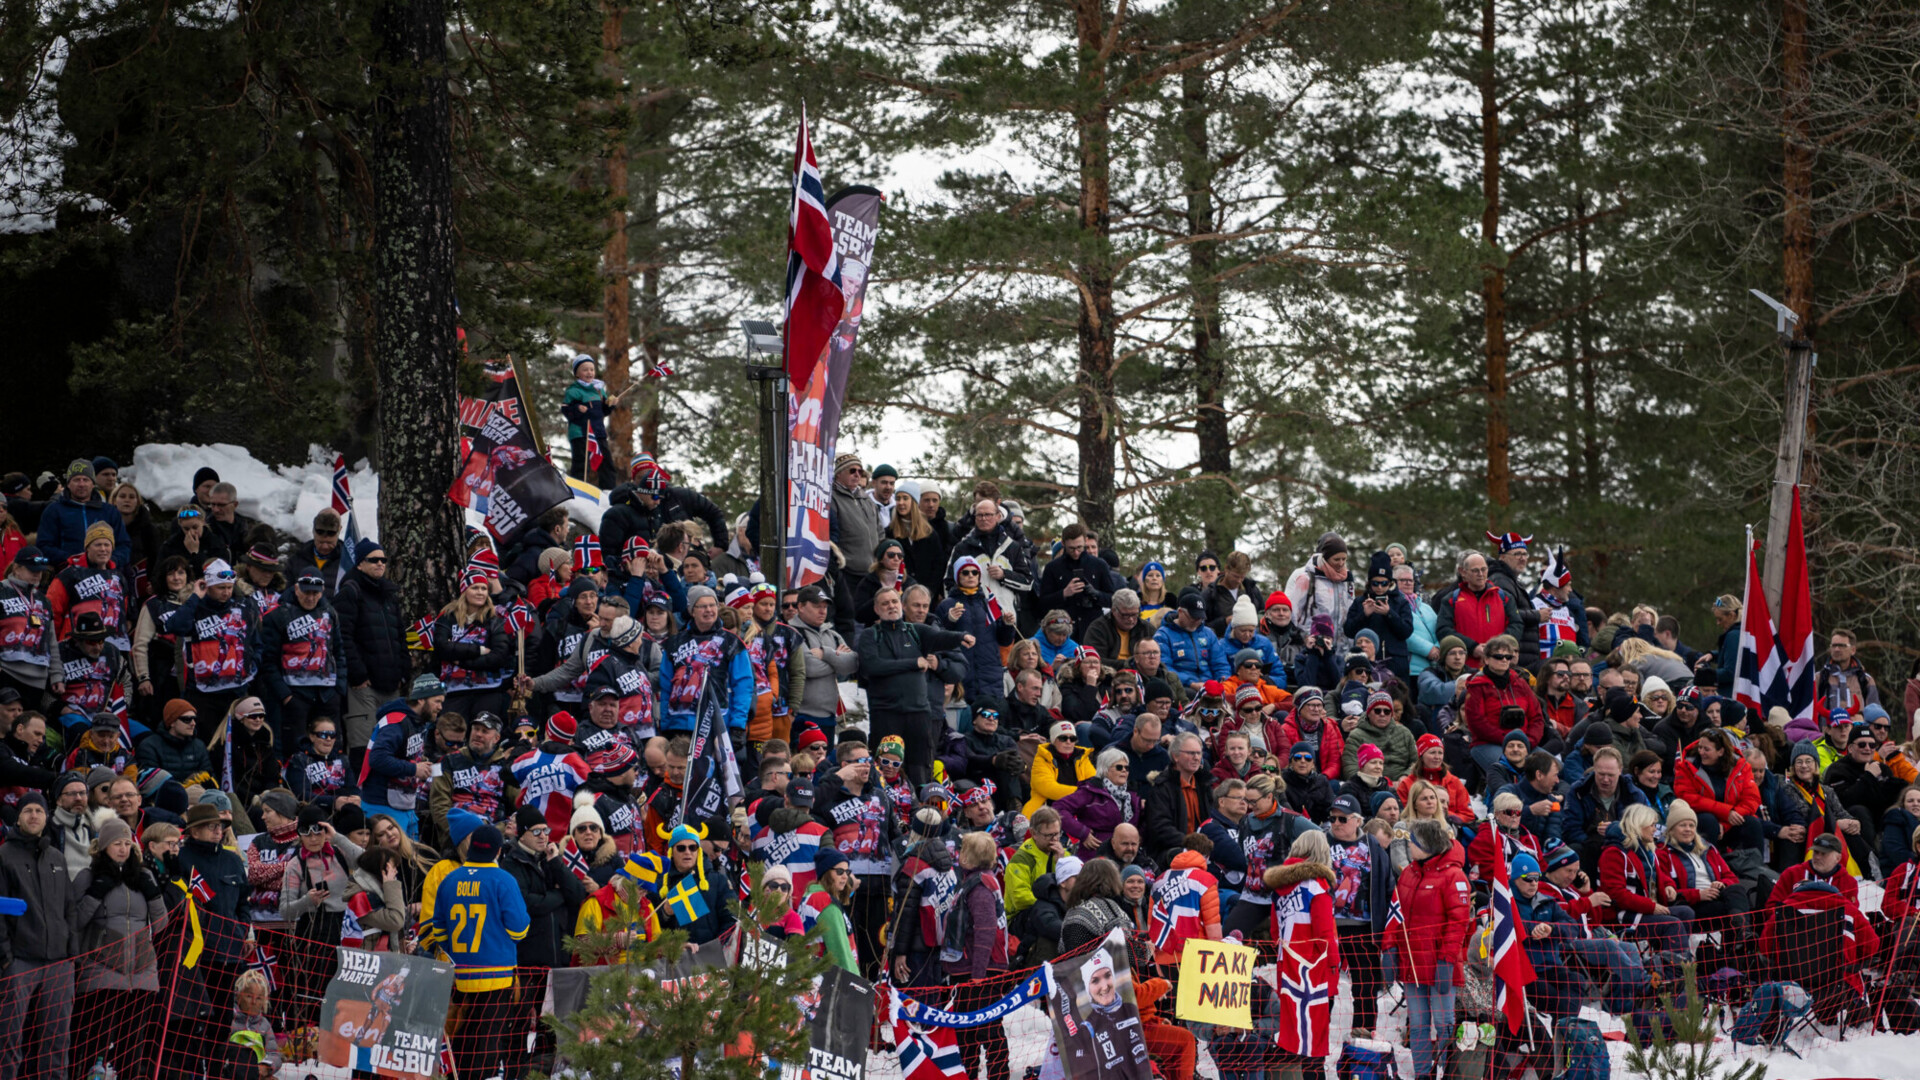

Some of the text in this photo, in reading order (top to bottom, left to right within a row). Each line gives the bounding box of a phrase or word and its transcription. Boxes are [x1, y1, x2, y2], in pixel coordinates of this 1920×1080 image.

[835, 210, 878, 246] TEAM
[493, 484, 528, 525] TEAM
[74, 573, 106, 595] HEIA
[79, 583, 110, 600] MARTE
[195, 614, 224, 632] HEIA
[198, 622, 228, 641] MARTE
[286, 613, 317, 634] HEIA
[287, 622, 320, 641] MARTE
[616, 669, 640, 686] HEIA
[582, 729, 614, 748] HEIA
[527, 762, 565, 782] TEAM
[608, 804, 632, 826] HEIA
[830, 797, 865, 818] HEIA
[836, 804, 869, 825] MARTE
[763, 829, 796, 855] TEAM
[456, 881, 481, 897] BOLIN
[1157, 873, 1188, 896] TEAM
[450, 903, 487, 953] 27
[342, 950, 380, 975] HEIA
[1198, 950, 1248, 976] TAKK
[337, 968, 378, 986] MARTE
[1198, 981, 1250, 1009] MARTE
[394, 1030, 438, 1054] TEAM
[369, 1043, 437, 1077] OLSBU
[810, 1046, 862, 1080] TEAM
